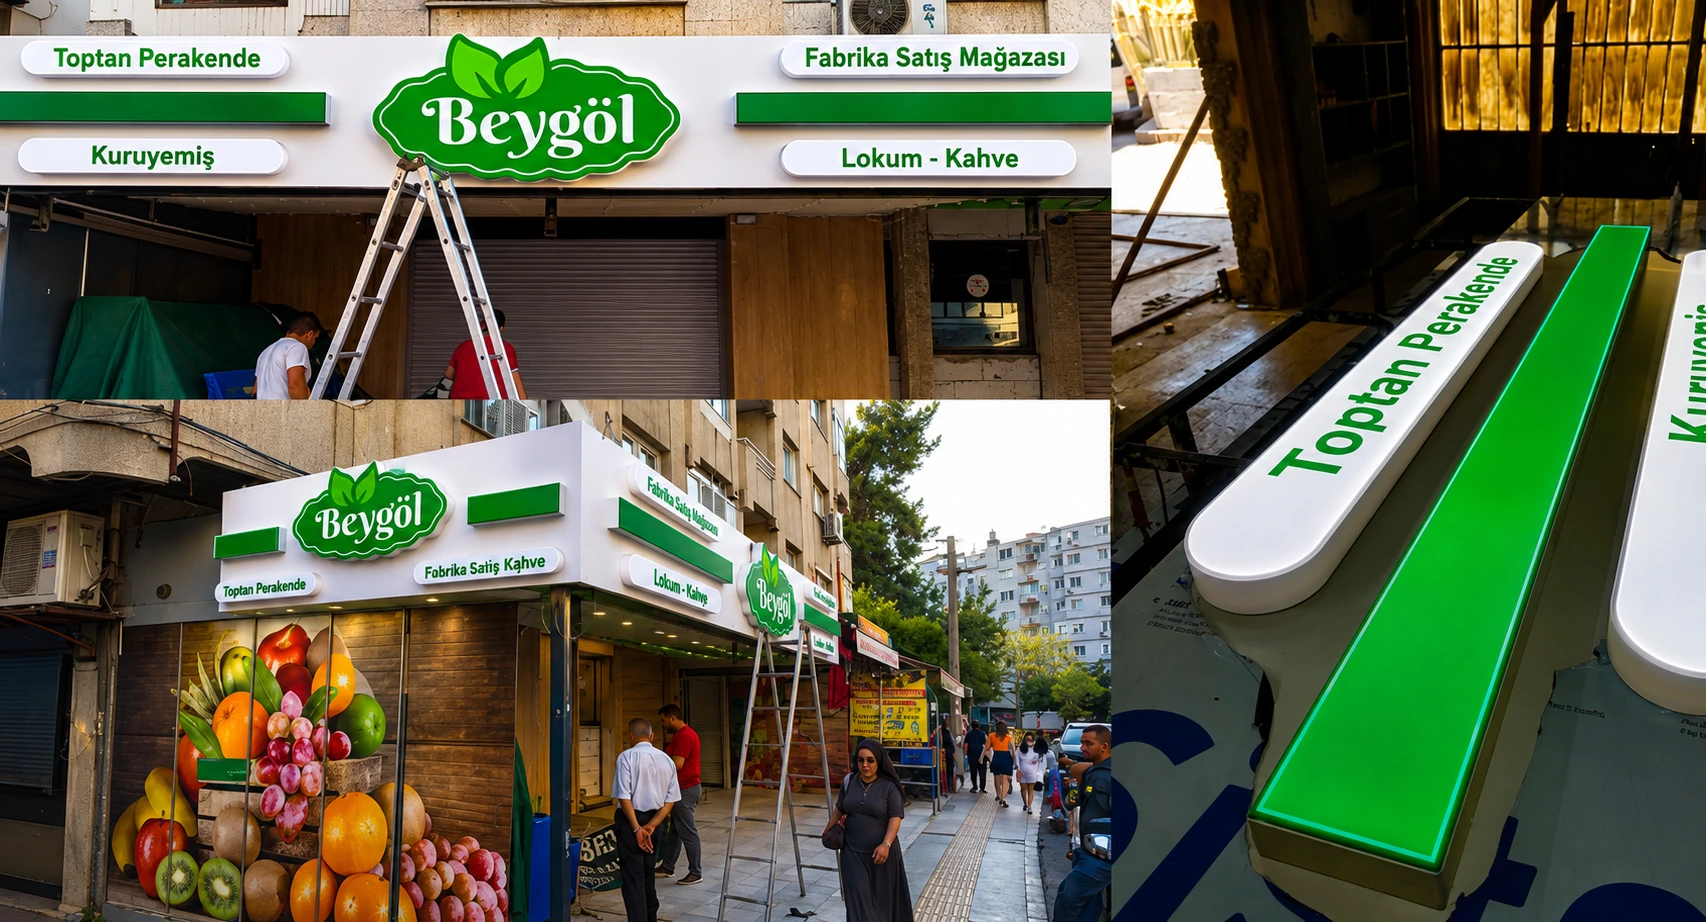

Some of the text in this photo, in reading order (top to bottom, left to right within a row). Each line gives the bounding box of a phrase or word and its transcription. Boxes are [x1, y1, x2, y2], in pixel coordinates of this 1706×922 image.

[53, 47, 261, 72] Toptan Perakende
[805, 46, 1066, 73] Fabrika Satış Mağazası
[421, 93, 635, 160] Beygöl
[91, 144, 215, 171] Kuruyemiş
[841, 147, 923, 169] Lokum
[945, 147, 1019, 169] Kahve
[1267, 256, 1519, 478] Toptan Perakende
[314, 490, 422, 545] Beygöl
[223, 578, 306, 599] Toptan Perakende
[653, 567, 681, 594] Lokum
[756, 577, 792, 625] Beygöl
